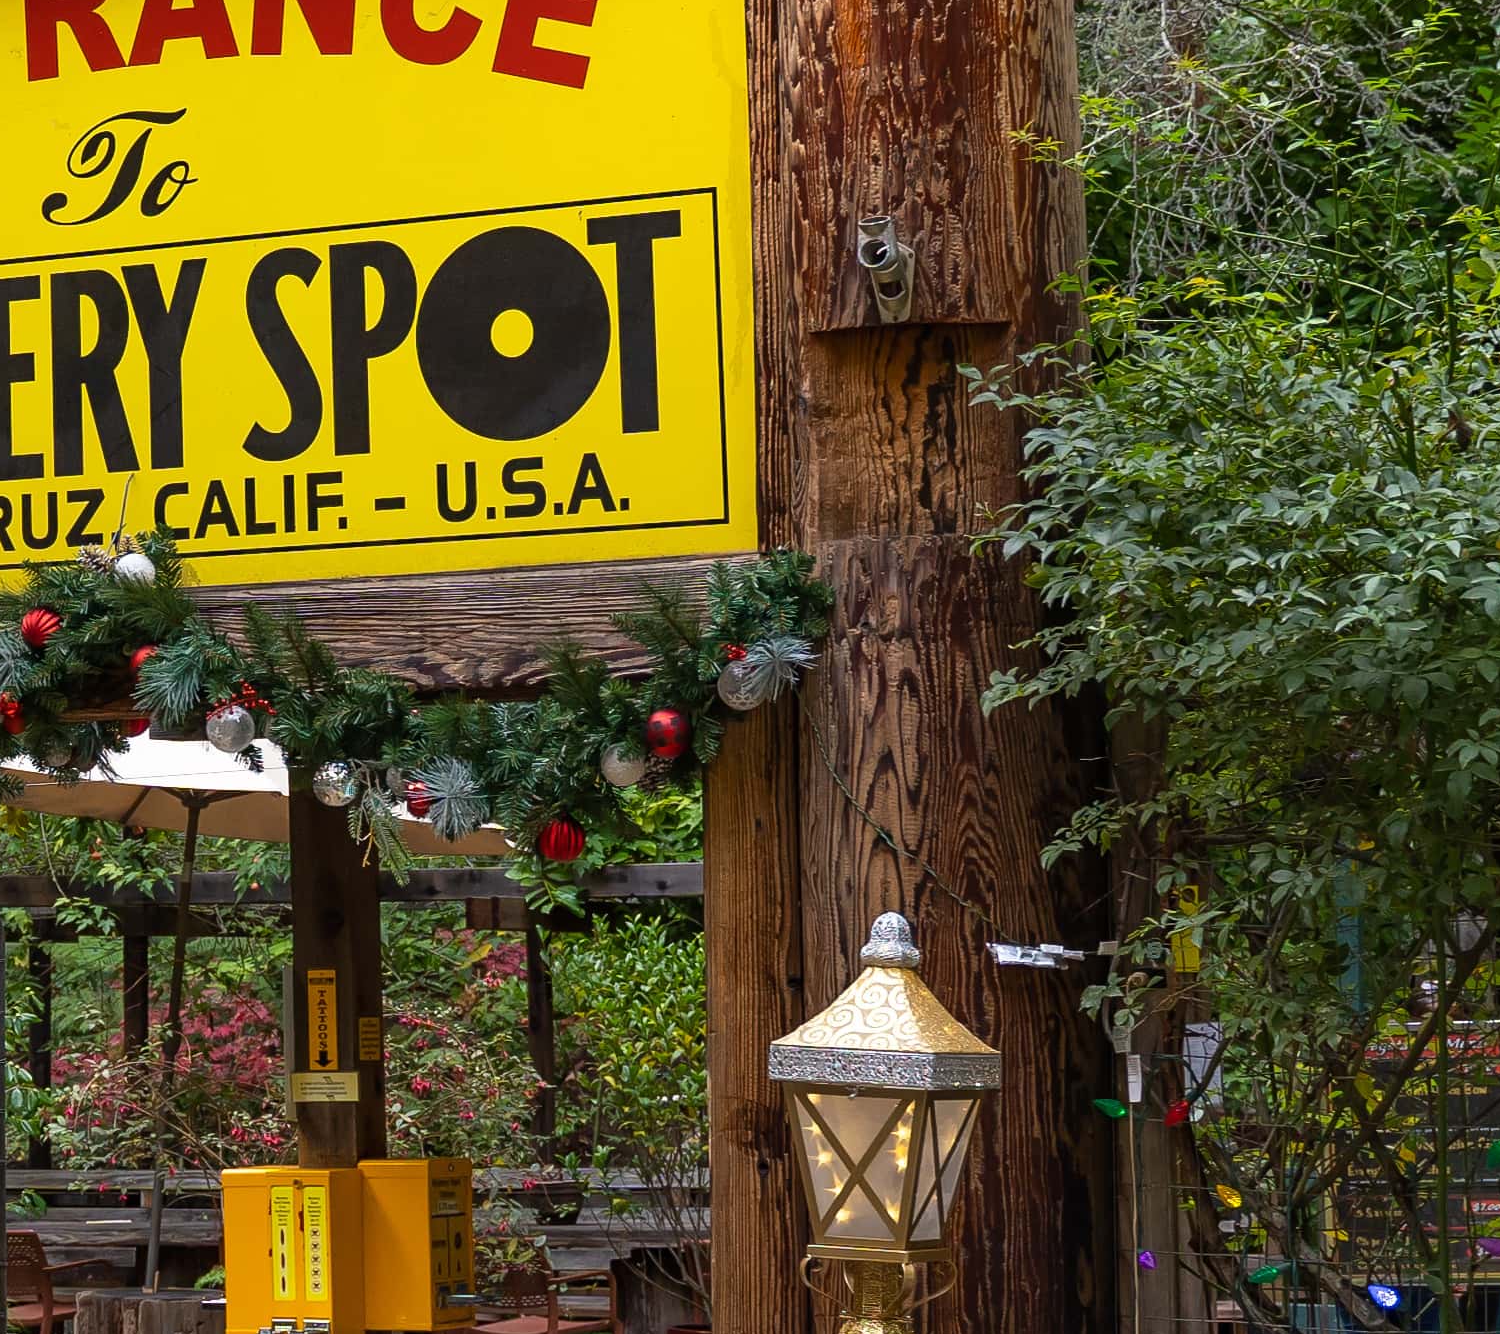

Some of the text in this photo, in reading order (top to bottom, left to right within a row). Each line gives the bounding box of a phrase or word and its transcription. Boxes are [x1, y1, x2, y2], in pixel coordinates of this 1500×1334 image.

[41, 108, 199, 225] To
[242, 209, 682, 462] SPOT
[153, 470, 348, 543] CALIF.
[375, 495, 405, 512] -
[435, 452, 631, 524] U.S.A.
[317, 989, 328, 1049] TATTOOS
